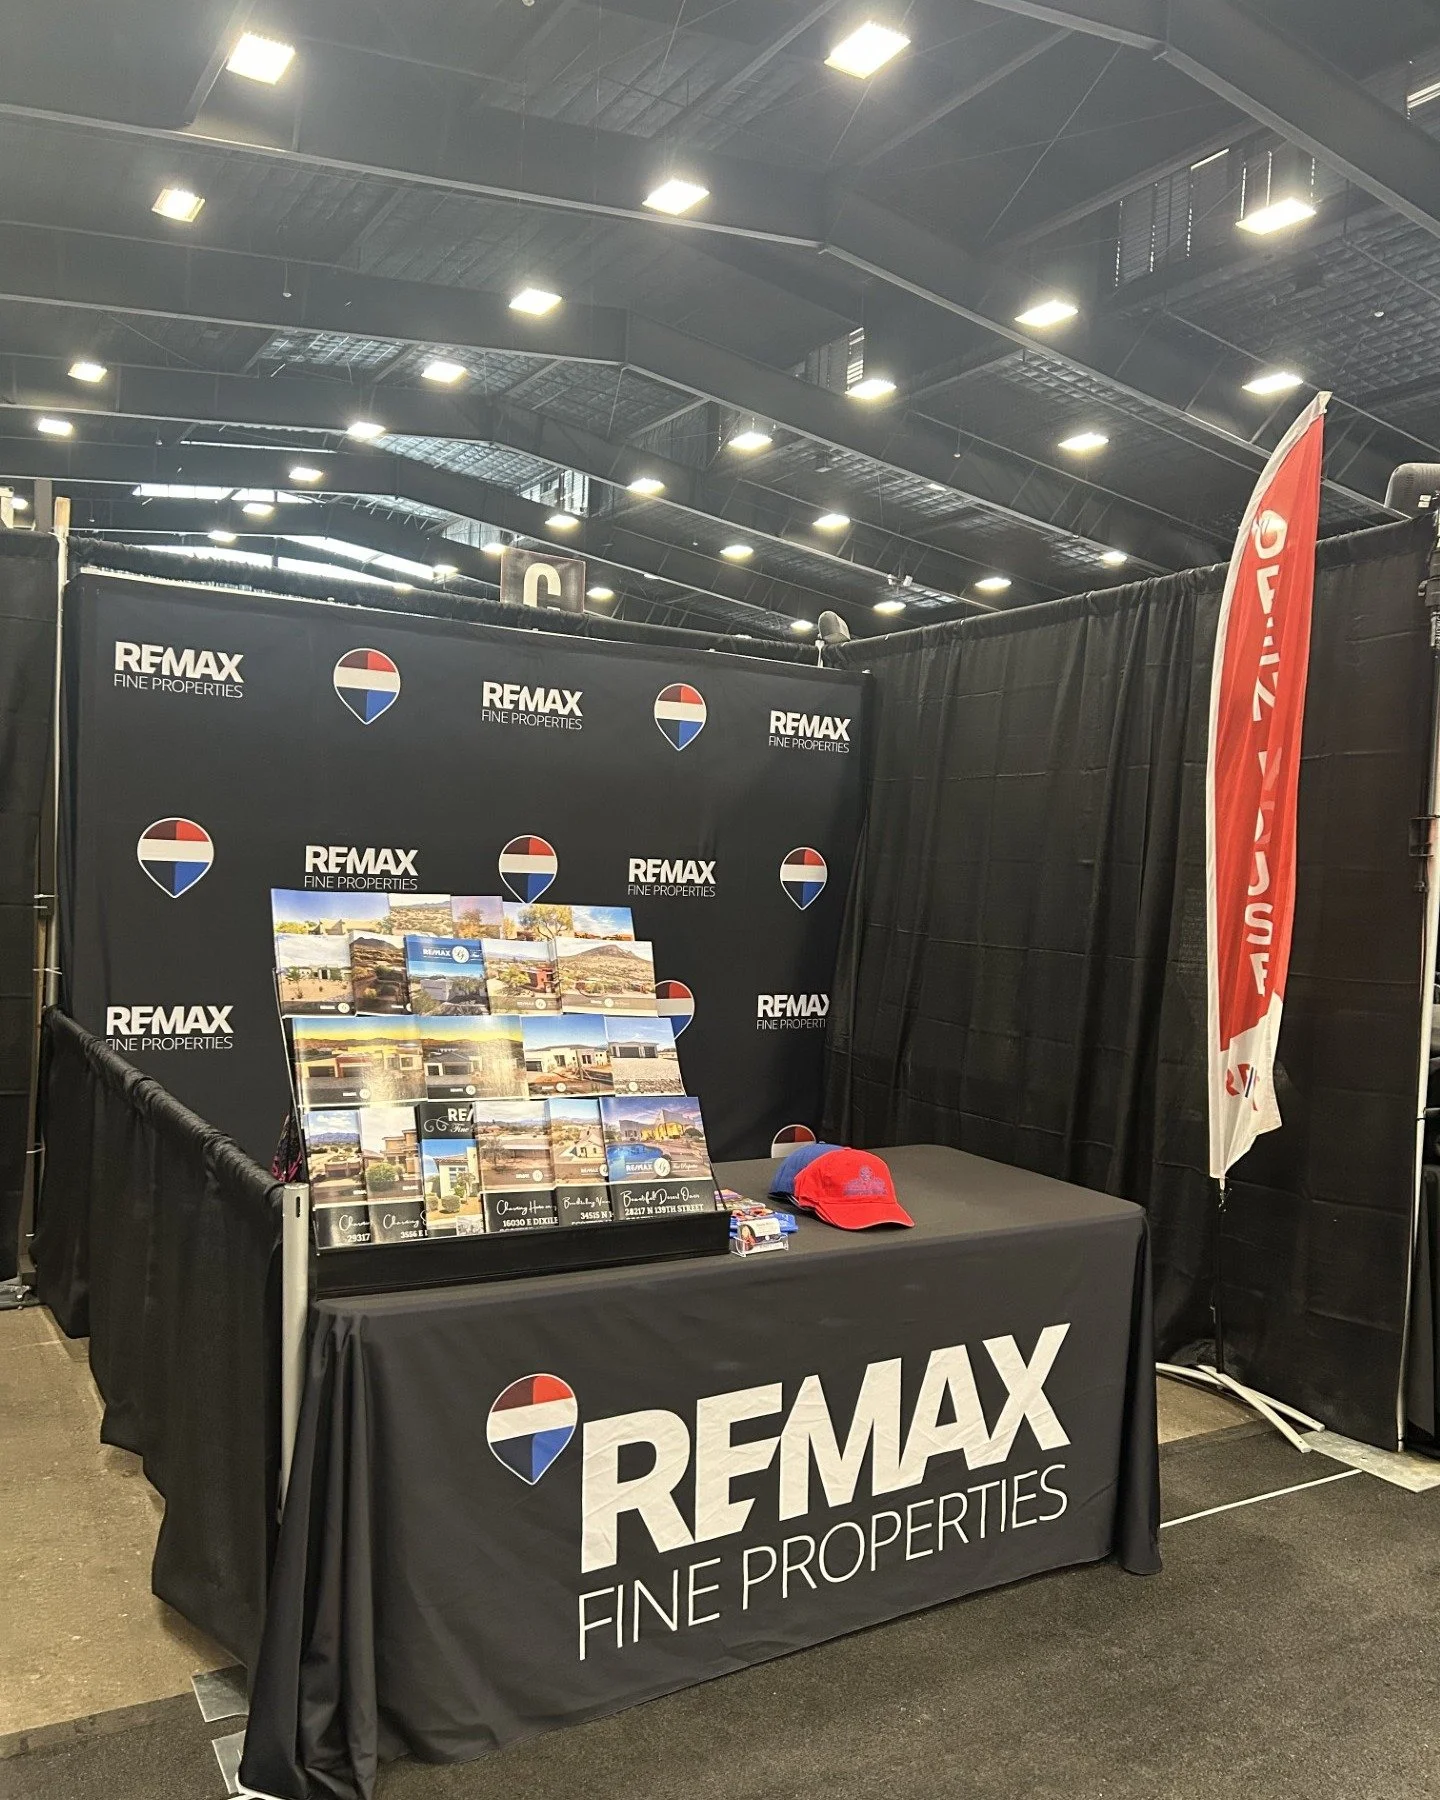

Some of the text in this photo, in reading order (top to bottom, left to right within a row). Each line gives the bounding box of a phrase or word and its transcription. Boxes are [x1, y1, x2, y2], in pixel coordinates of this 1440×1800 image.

[113, 673, 244, 699] FINE PROPERTIES
[481, 709, 582, 731] FINE PROPERTIES
[768, 736, 850, 754] FINE PROPERTIES
[304, 875, 418, 891] FINE PROPERTIES
[627, 884, 716, 898] FINE PROPERTIES
[756, 1019, 778, 1030] FINE
[141, 1036, 234, 1051] PROPERTIES
[624, 1206, 646, 1216] 28217
[647, 1207, 654, 1215] N
[677, 1203, 704, 1213] STREET
[526, 1218, 532, 1226] E
[577, 1463, 1069, 1661] FINE PROPERTIES
